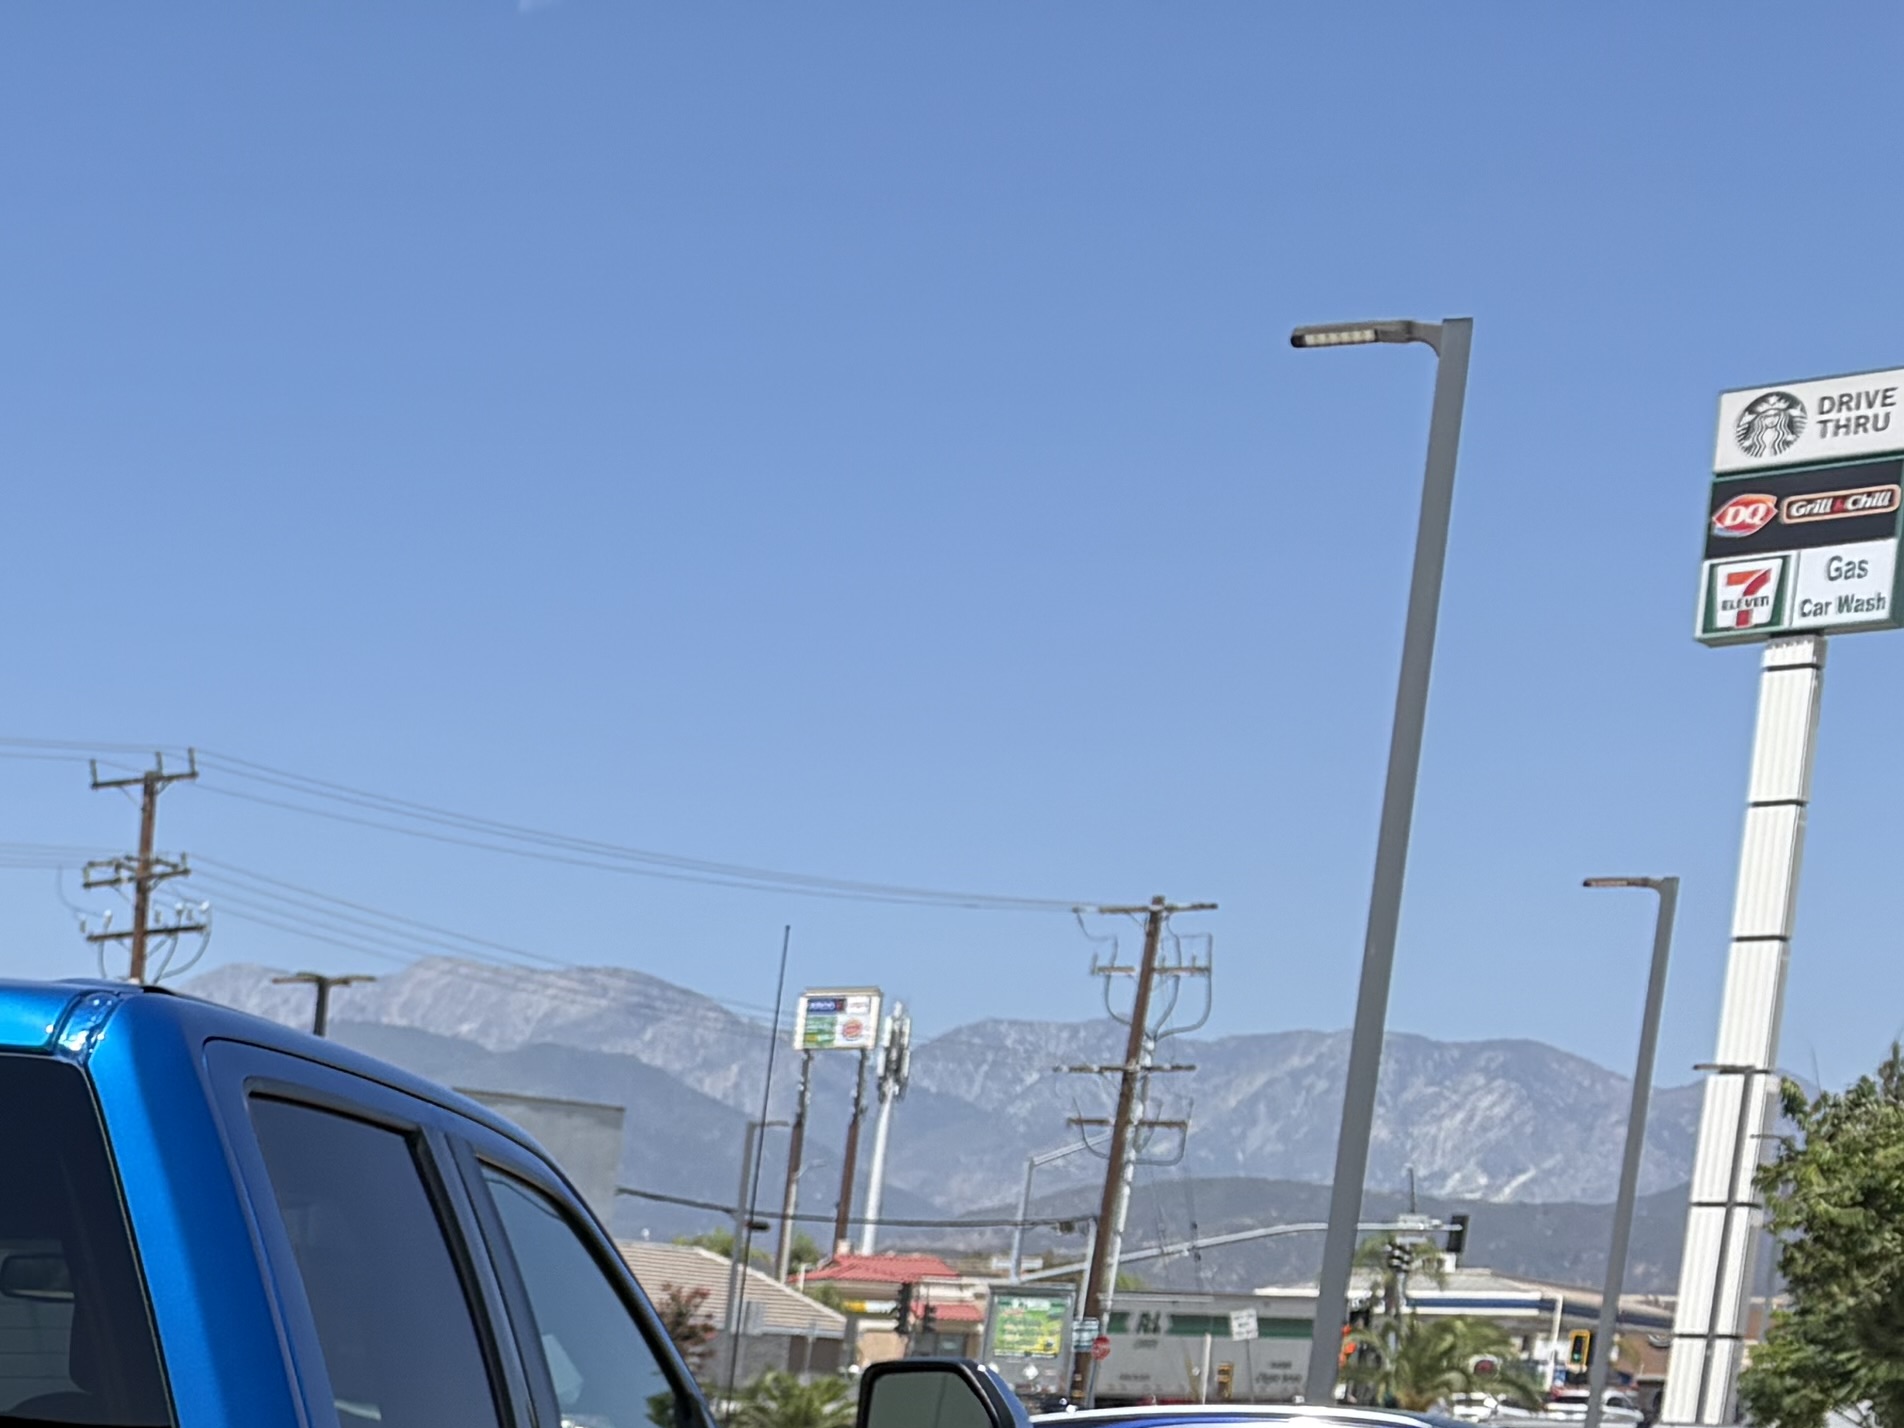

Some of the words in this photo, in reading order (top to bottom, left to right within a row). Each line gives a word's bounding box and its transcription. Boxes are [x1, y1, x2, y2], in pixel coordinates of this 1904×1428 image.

[1818, 387, 1897, 415] DRIVE
[1818, 411, 1891, 438] THRU
[1725, 504, 1765, 525] DQ
[1790, 497, 1833, 516] Grill
[1845, 491, 1892, 510] Chill
[1826, 555, 1869, 582] Gas
[1800, 598, 1832, 618] Car
[1837, 592, 1886, 614] Wash
